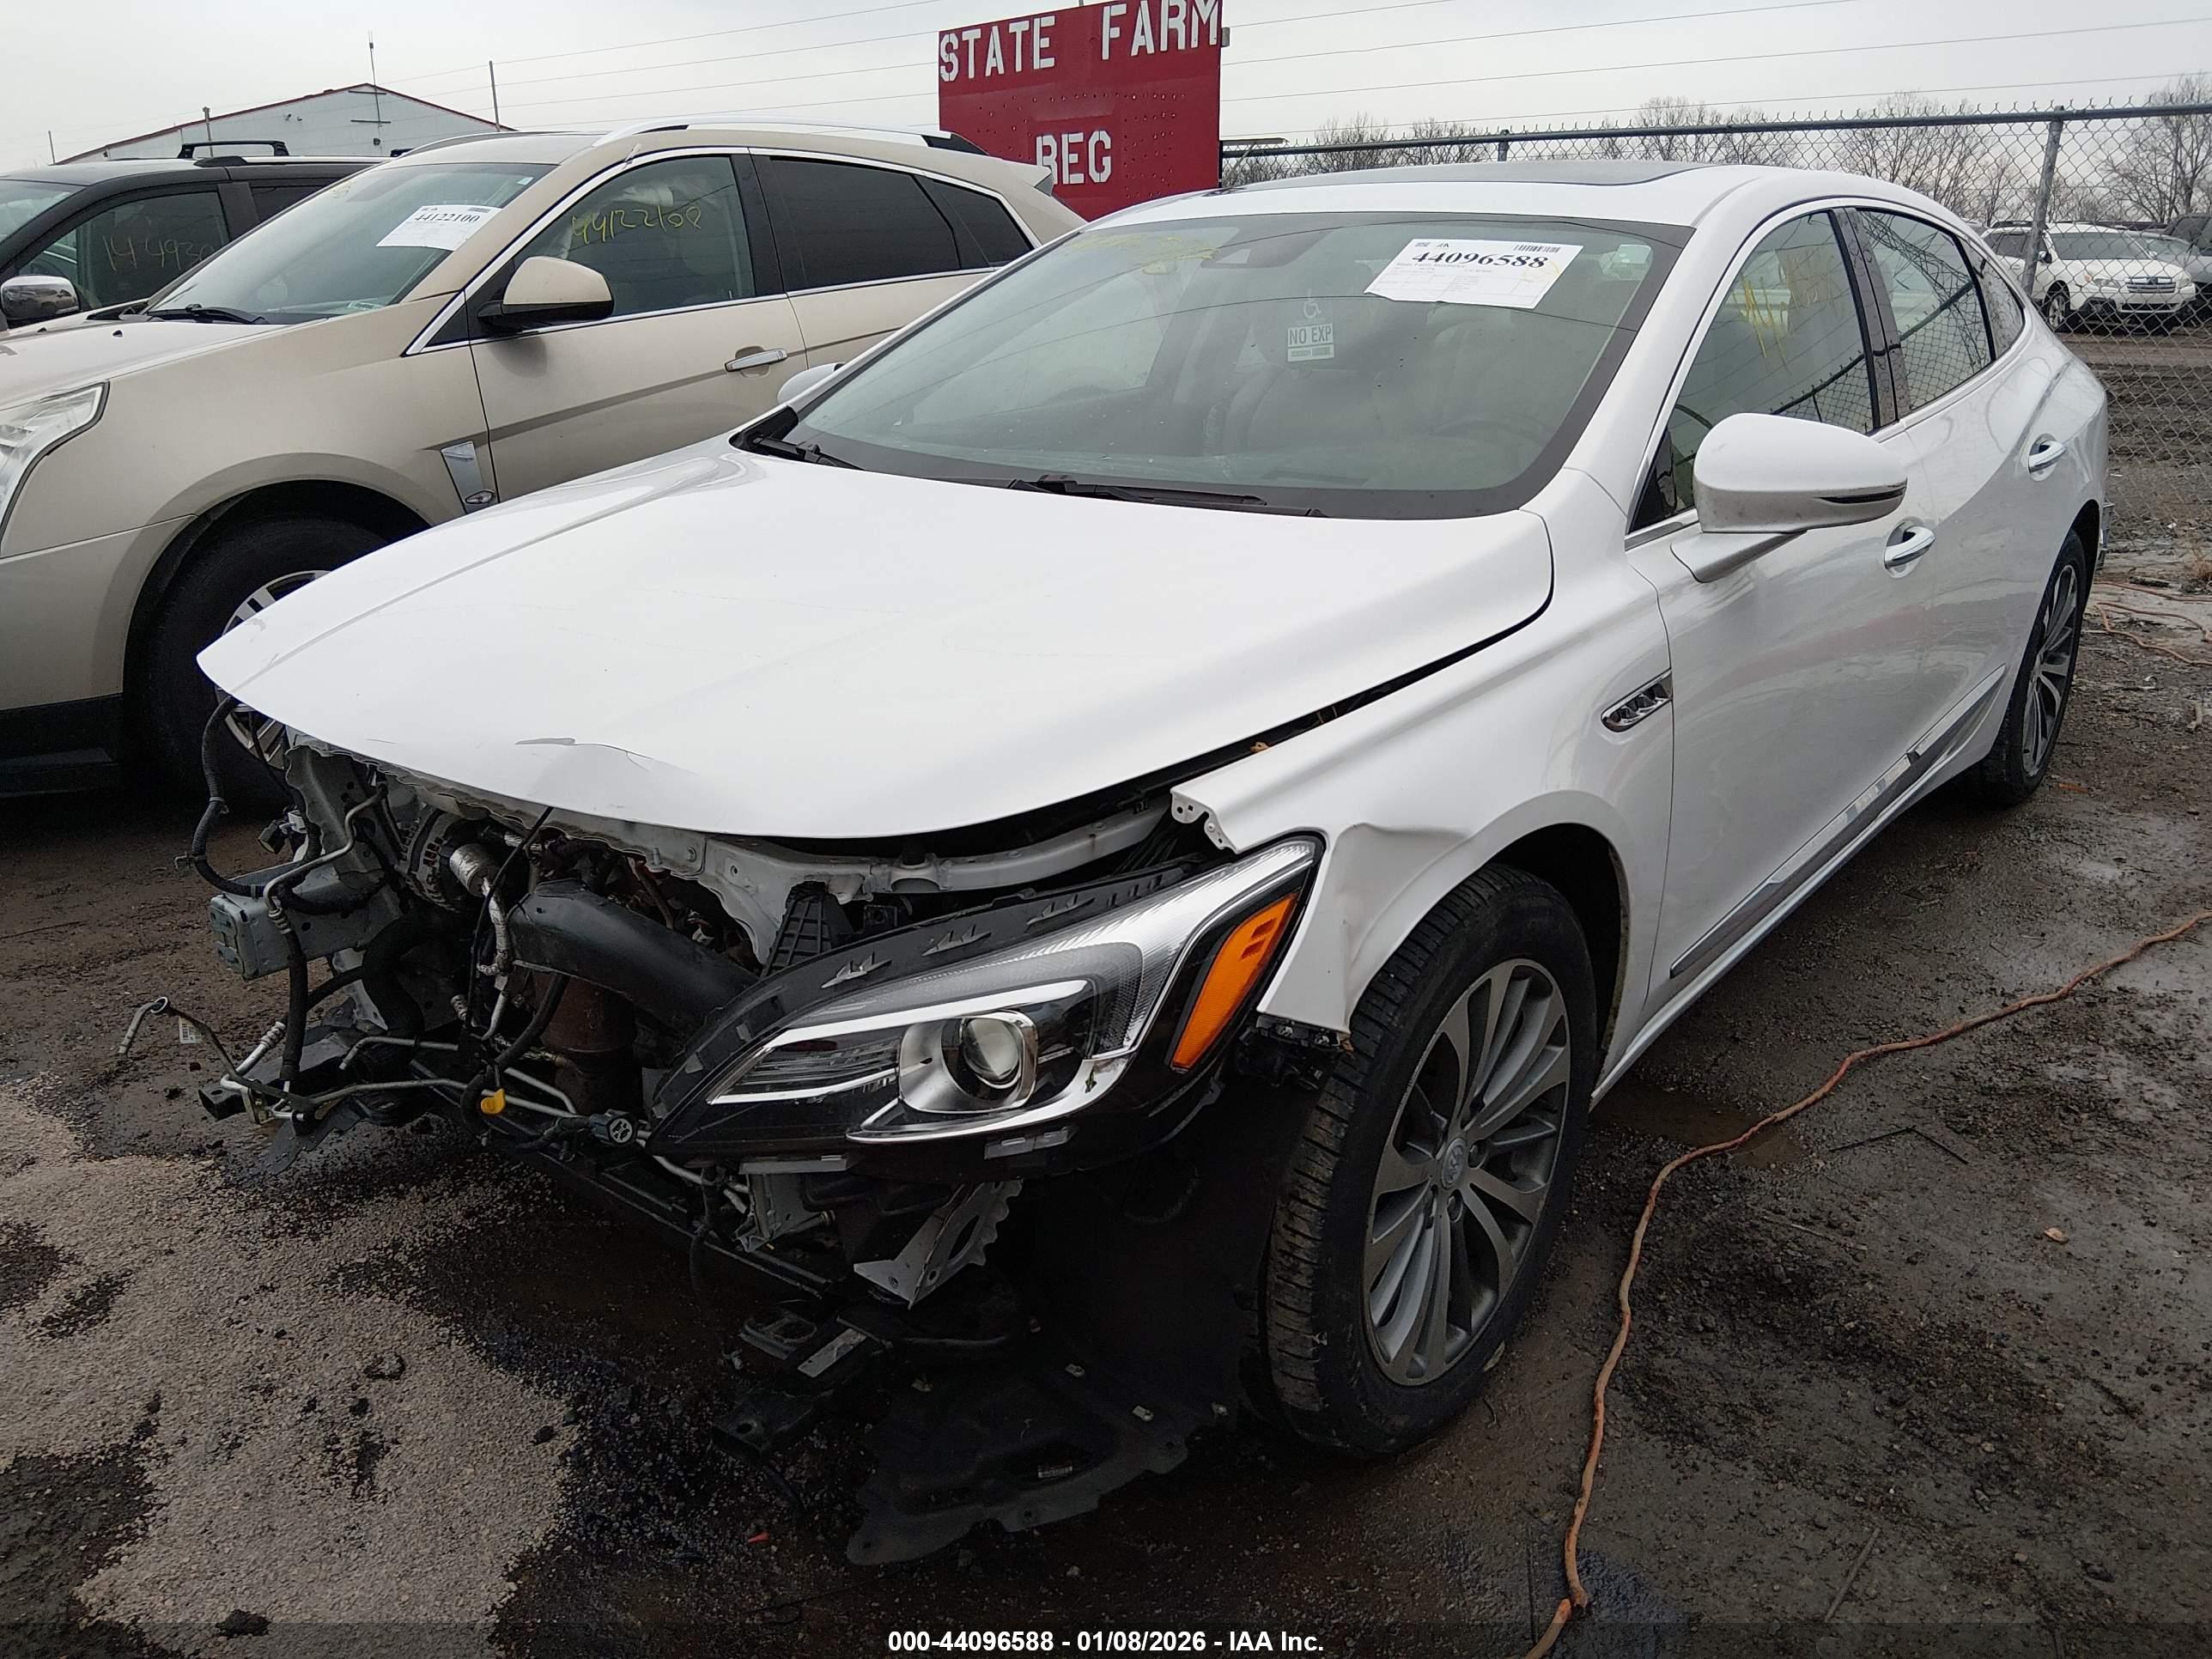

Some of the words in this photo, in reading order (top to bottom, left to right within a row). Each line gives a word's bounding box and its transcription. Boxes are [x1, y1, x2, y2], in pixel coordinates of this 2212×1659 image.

[939, 15, 1055, 82] STATE
[1102, 0, 1218, 60] FARM
[1036, 130, 1112, 185] REG
[413, 213, 481, 223] 44122100
[1410, 252, 1549, 269] 44096588
[1289, 328, 1307, 345] NO
[1311, 325, 1332, 343] EXP
